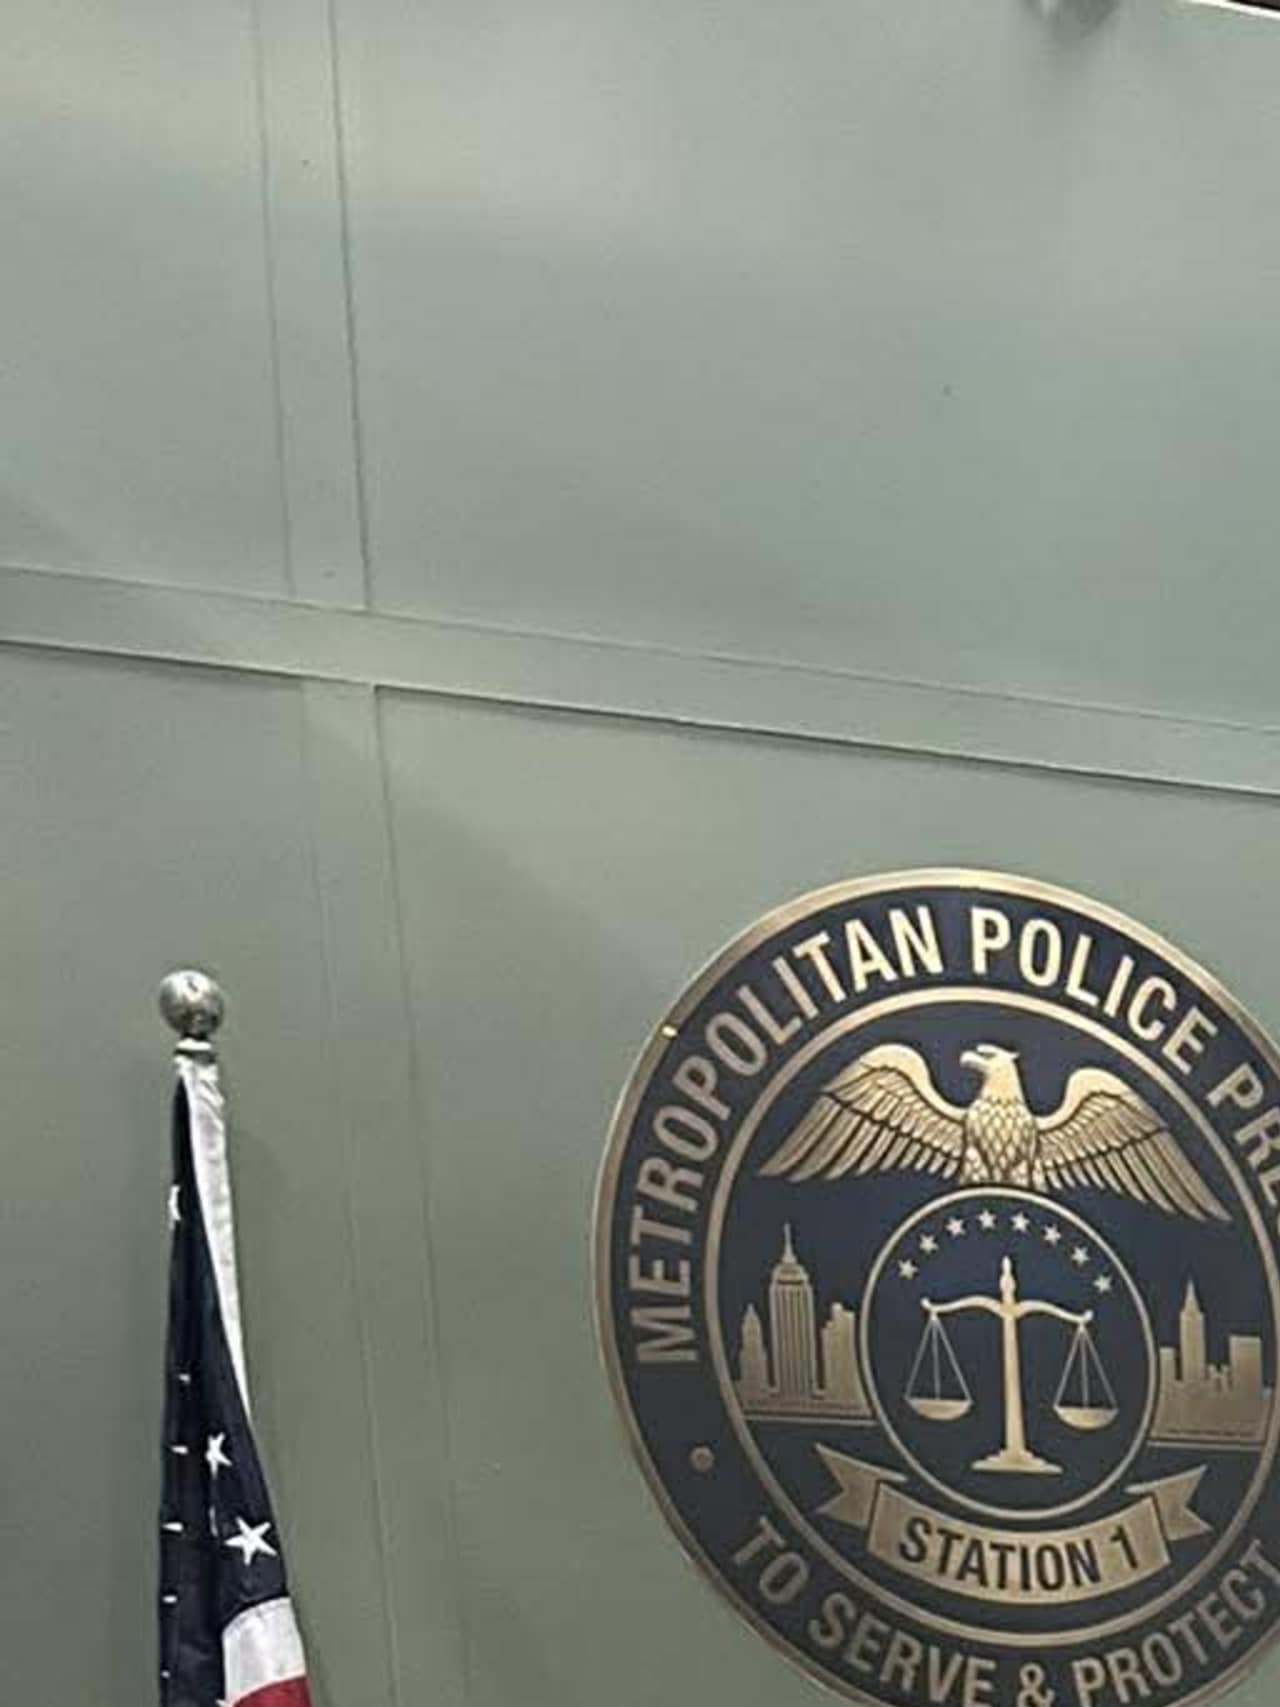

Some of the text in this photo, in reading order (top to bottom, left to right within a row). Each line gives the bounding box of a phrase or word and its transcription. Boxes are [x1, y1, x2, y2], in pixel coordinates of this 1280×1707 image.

[627, 906, 944, 1364] METROPOLITAN
[971, 907, 1216, 1075] POLICE
[727, 1516, 812, 1605] TO
[897, 1517, 1138, 1592] STATION 1
